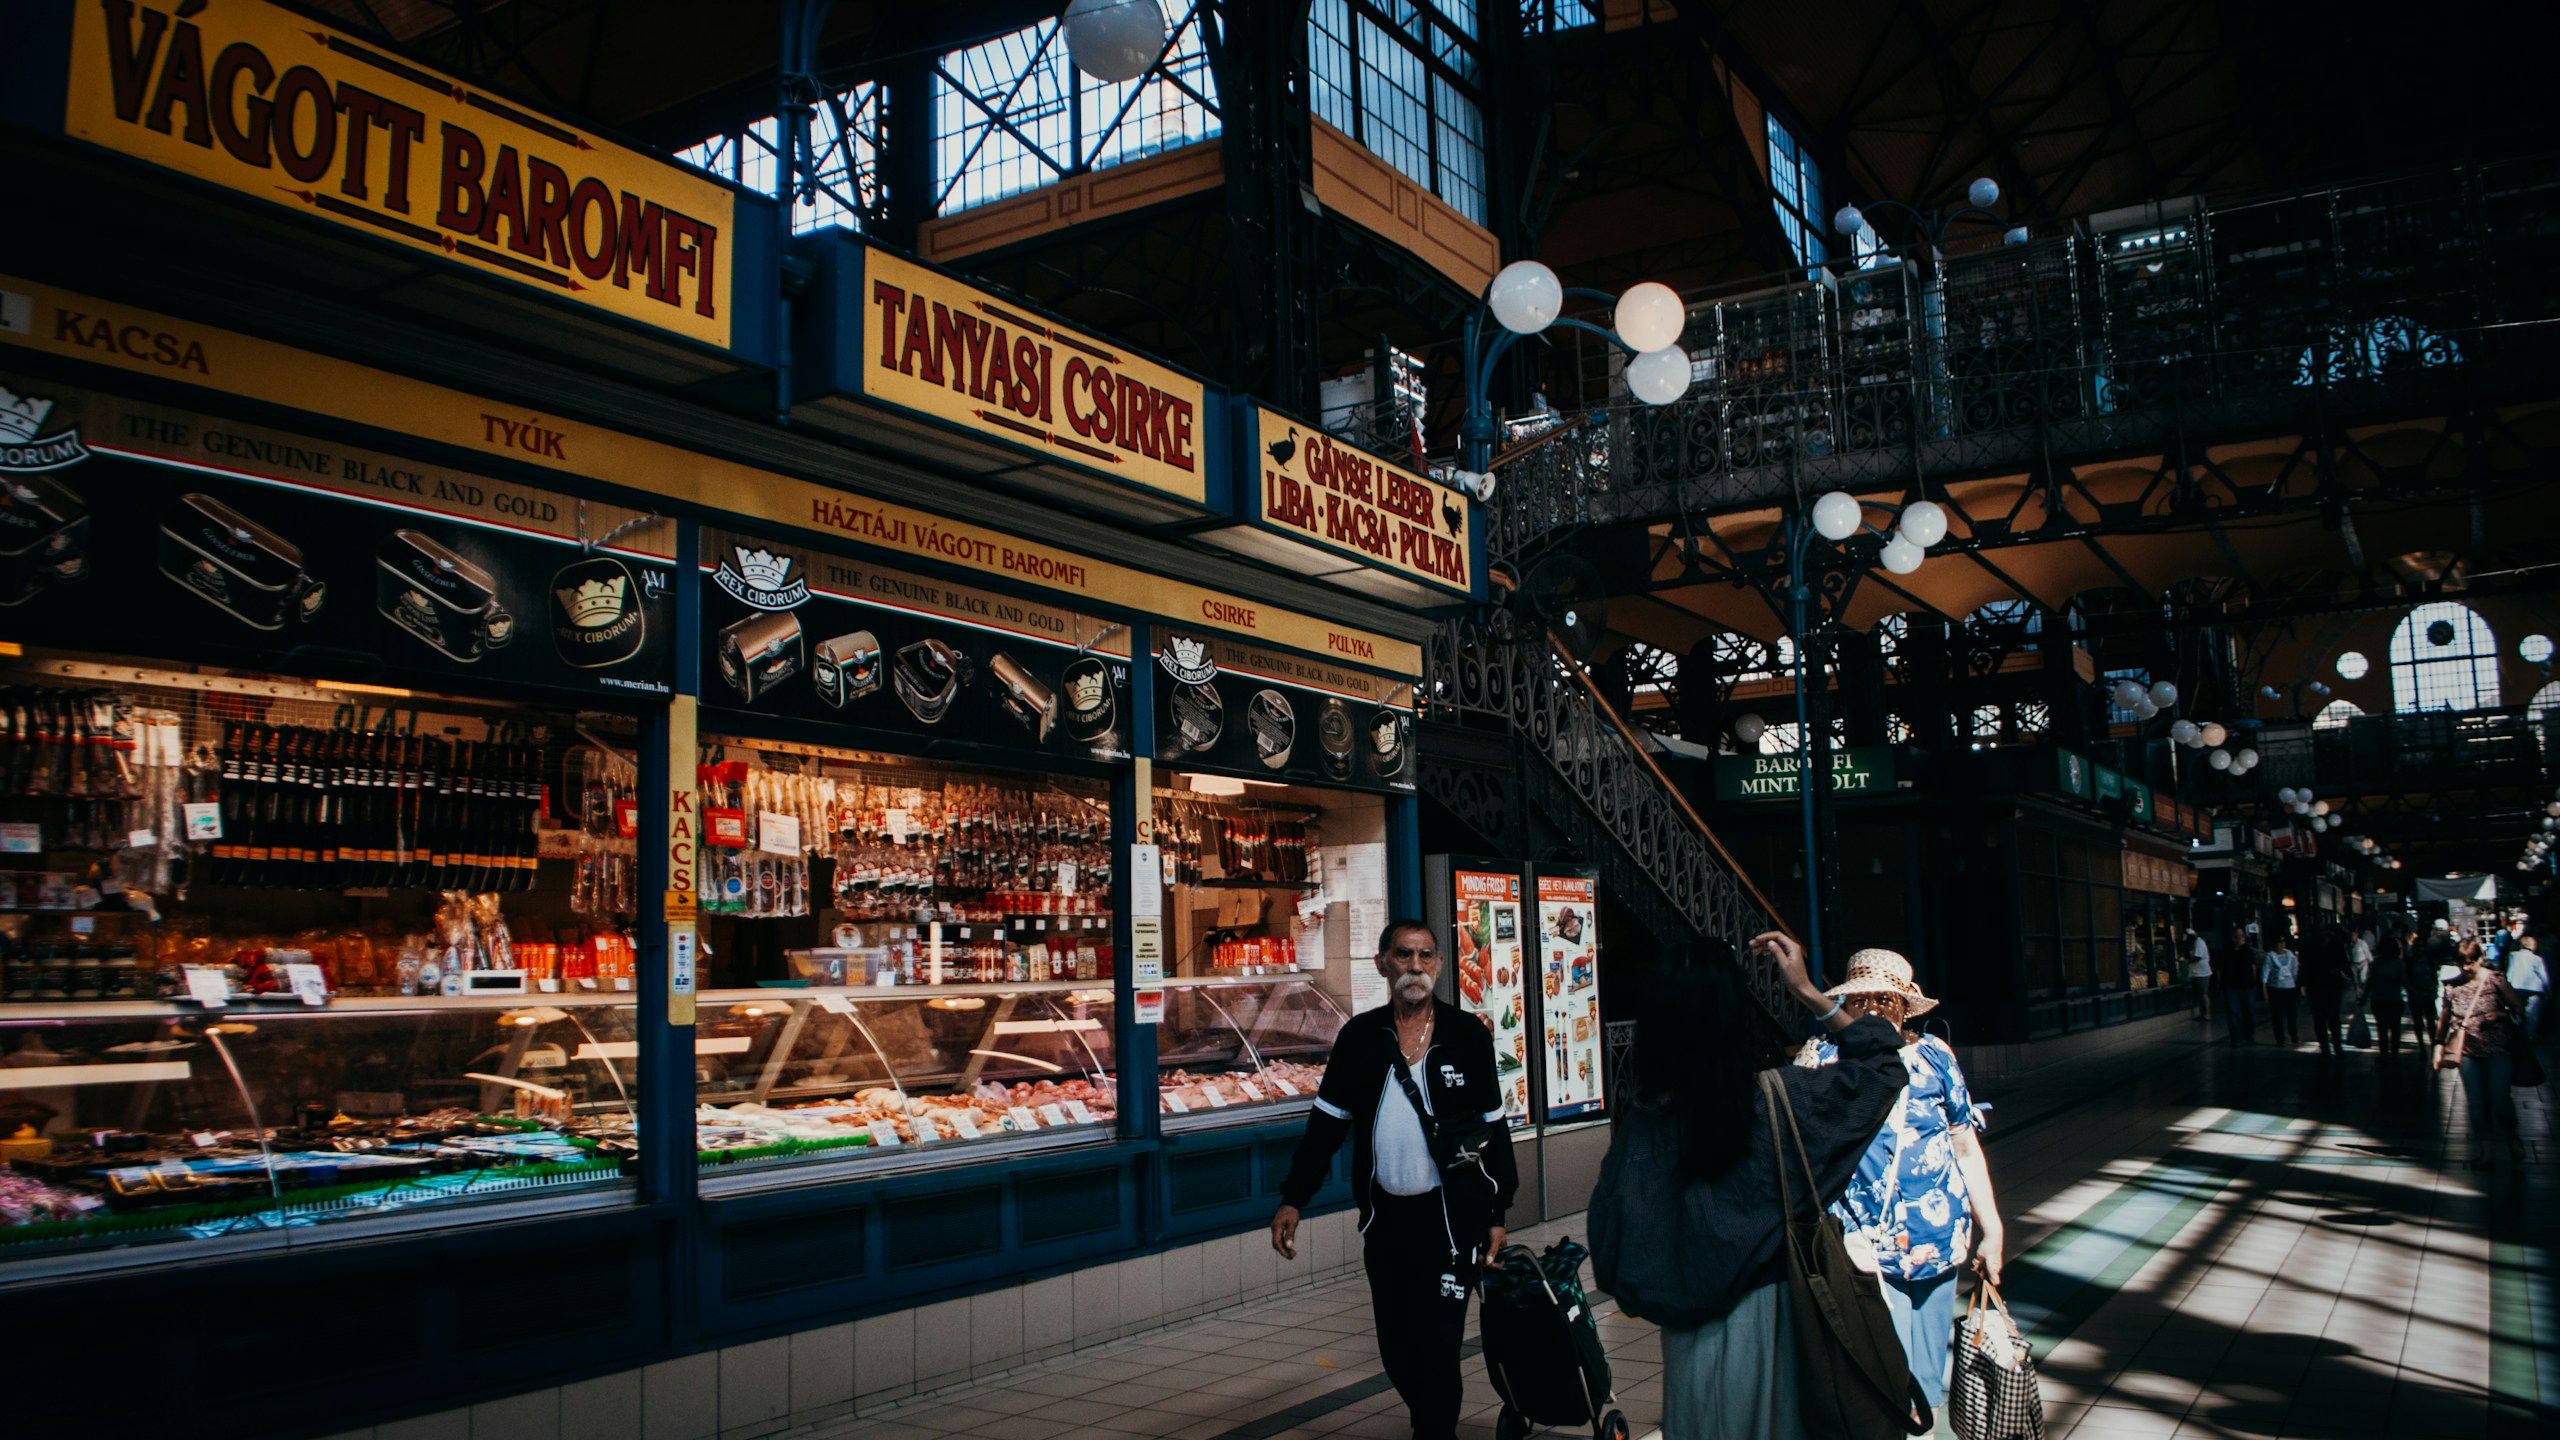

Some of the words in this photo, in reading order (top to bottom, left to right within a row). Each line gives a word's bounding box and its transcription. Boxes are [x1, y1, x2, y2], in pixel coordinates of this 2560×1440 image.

[103, 0, 424, 215] VÁGOTT
[436, 122, 717, 320] BAROMFI
[54, 307, 210, 374] KACSA
[873, 279, 1052, 424] TANYASI
[1063, 356, 1194, 473] CSIRKE
[480, 413, 566, 460] TYÚK
[123, 413, 189, 447] THE
[203, 430, 330, 475] GENUINE
[342, 459, 423, 494] BLACK
[432, 479, 483, 507] AND
[494, 493, 557, 522] GOLD
[1305, 435, 1373, 505] GÄNSE
[1376, 465, 1435, 529] LEBER
[812, 497, 907, 544] HÁZTÁJI
[913, 522, 996, 565] VÁGOTT
[1002, 548, 1086, 588] BAROMFI
[1266, 470, 1317, 533] LIBA
[1326, 492, 1392, 560] KACSA
[1399, 520, 1466, 585] PULYKA
[720, 571, 745, 596] REX
[747, 586, 804, 606] CIBORUM
[827, 565, 863, 588] THE
[869, 575, 940, 605] GENUINE
[945, 591, 990, 616] BLACK
[995, 604, 1023, 623] AND
[1028, 612, 1065, 633] GOLD
[584, 612, 638, 644] CIBORUM
[1202, 599, 1256, 628] CSIRKE
[1163, 656, 1179, 674] REX
[1179, 664, 1214, 681] CIBORUM
[1328, 632, 1374, 659] PULYKA
[599, 677, 670, 693] www.merian.hu
[1225, 647, 1246, 665] THE
[1250, 654, 1293, 674] GENUINE
[1296, 664, 1323, 682] BLACK
[1326, 671, 1344, 686] AND
[1346, 677, 1370, 692] GOLD
[1081, 698, 1111, 723] CIBORUM
[1461, 875, 1486, 892] MINDIG
